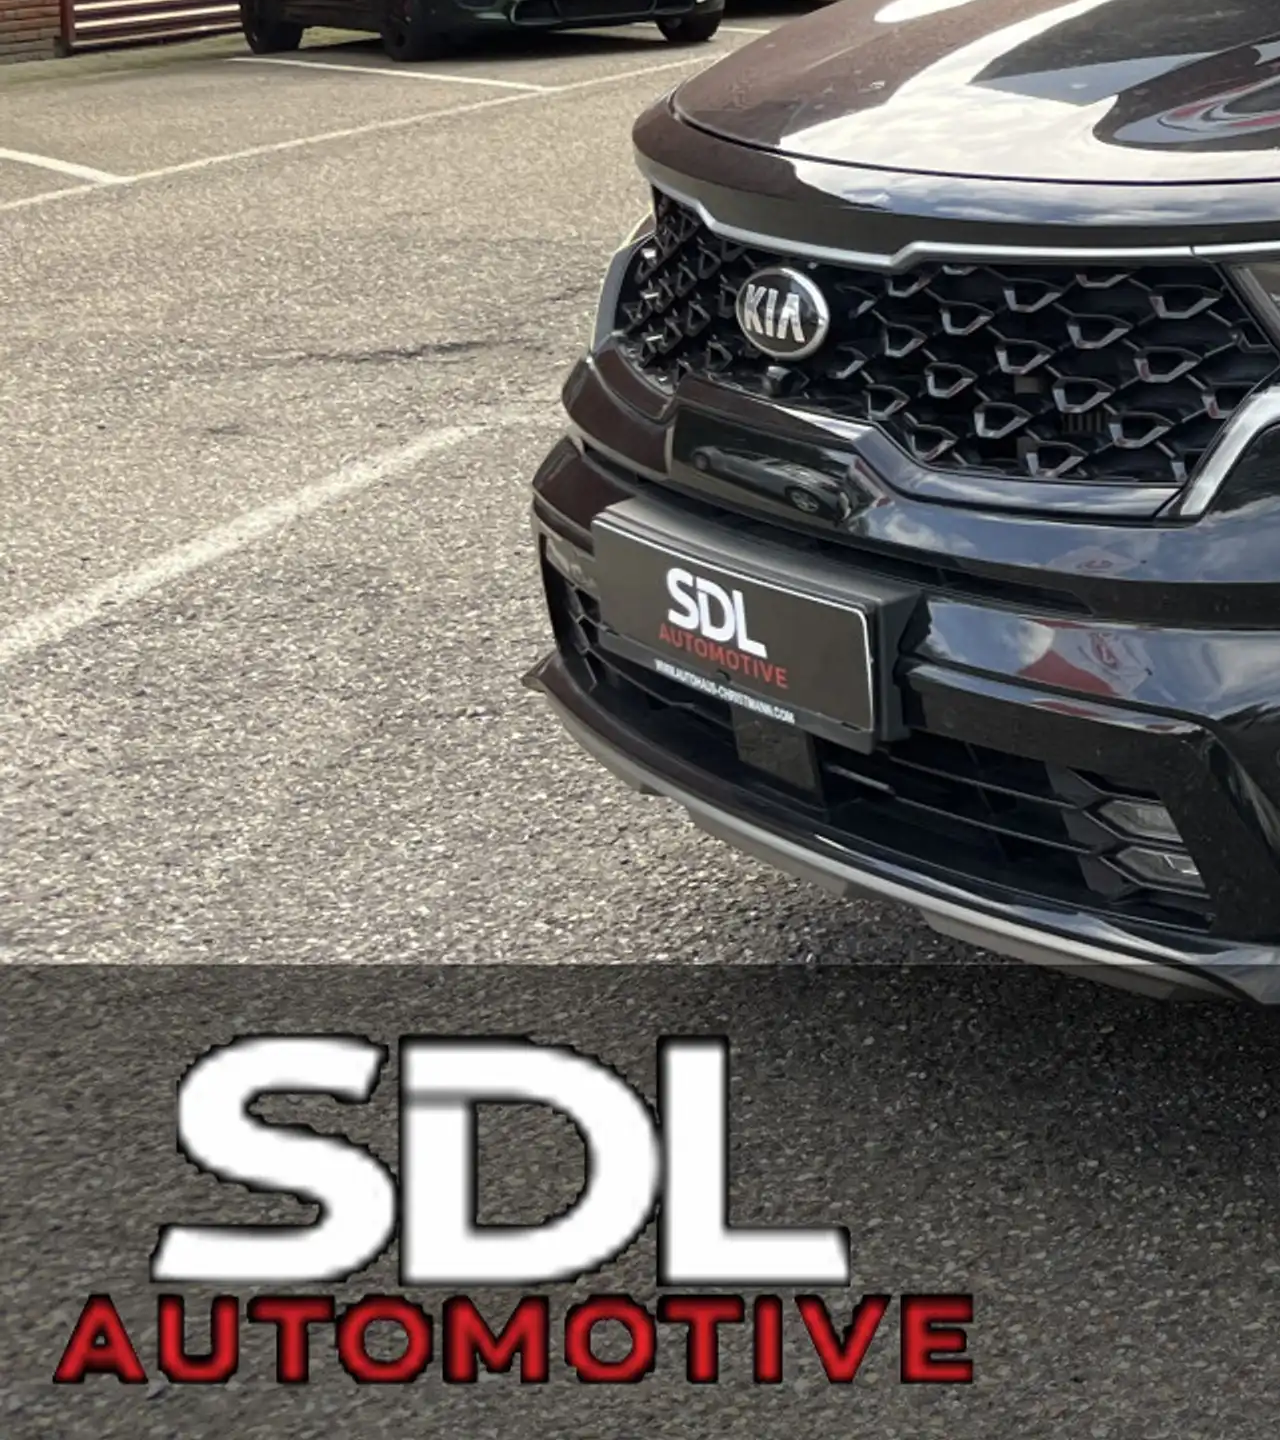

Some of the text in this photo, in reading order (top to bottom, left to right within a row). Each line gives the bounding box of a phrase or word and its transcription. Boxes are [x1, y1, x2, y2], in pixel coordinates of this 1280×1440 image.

[744, 283, 806, 344] KIA
[666, 567, 768, 660] SDL
[658, 622, 790, 690] AUTOMOTIVE
